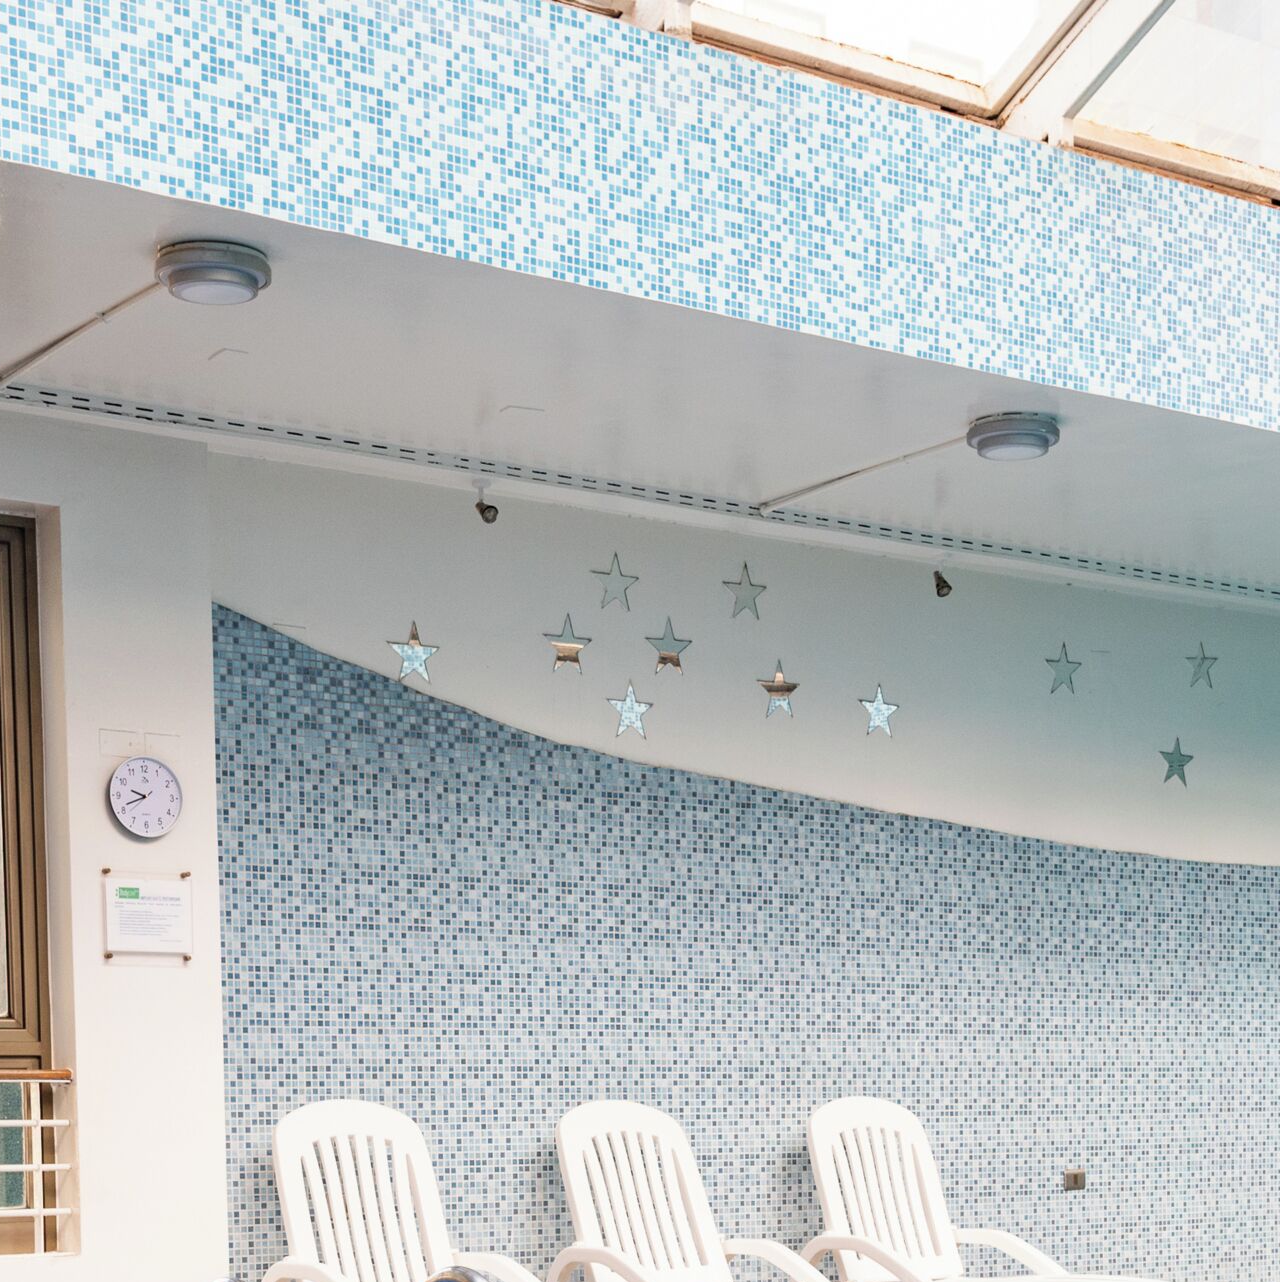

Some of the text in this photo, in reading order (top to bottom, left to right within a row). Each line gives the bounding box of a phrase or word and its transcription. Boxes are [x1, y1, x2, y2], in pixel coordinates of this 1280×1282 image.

[128, 768, 135, 776] 11
[140, 765, 148, 773] 12
[119, 778, 127, 786] 10
[165, 780, 170, 788] 2
[121, 806, 126, 814] 8
[166, 808, 171, 816] 4
[132, 816, 136, 824] 7
[158, 818, 162, 826] 5
[144, 821, 149, 829] 6
